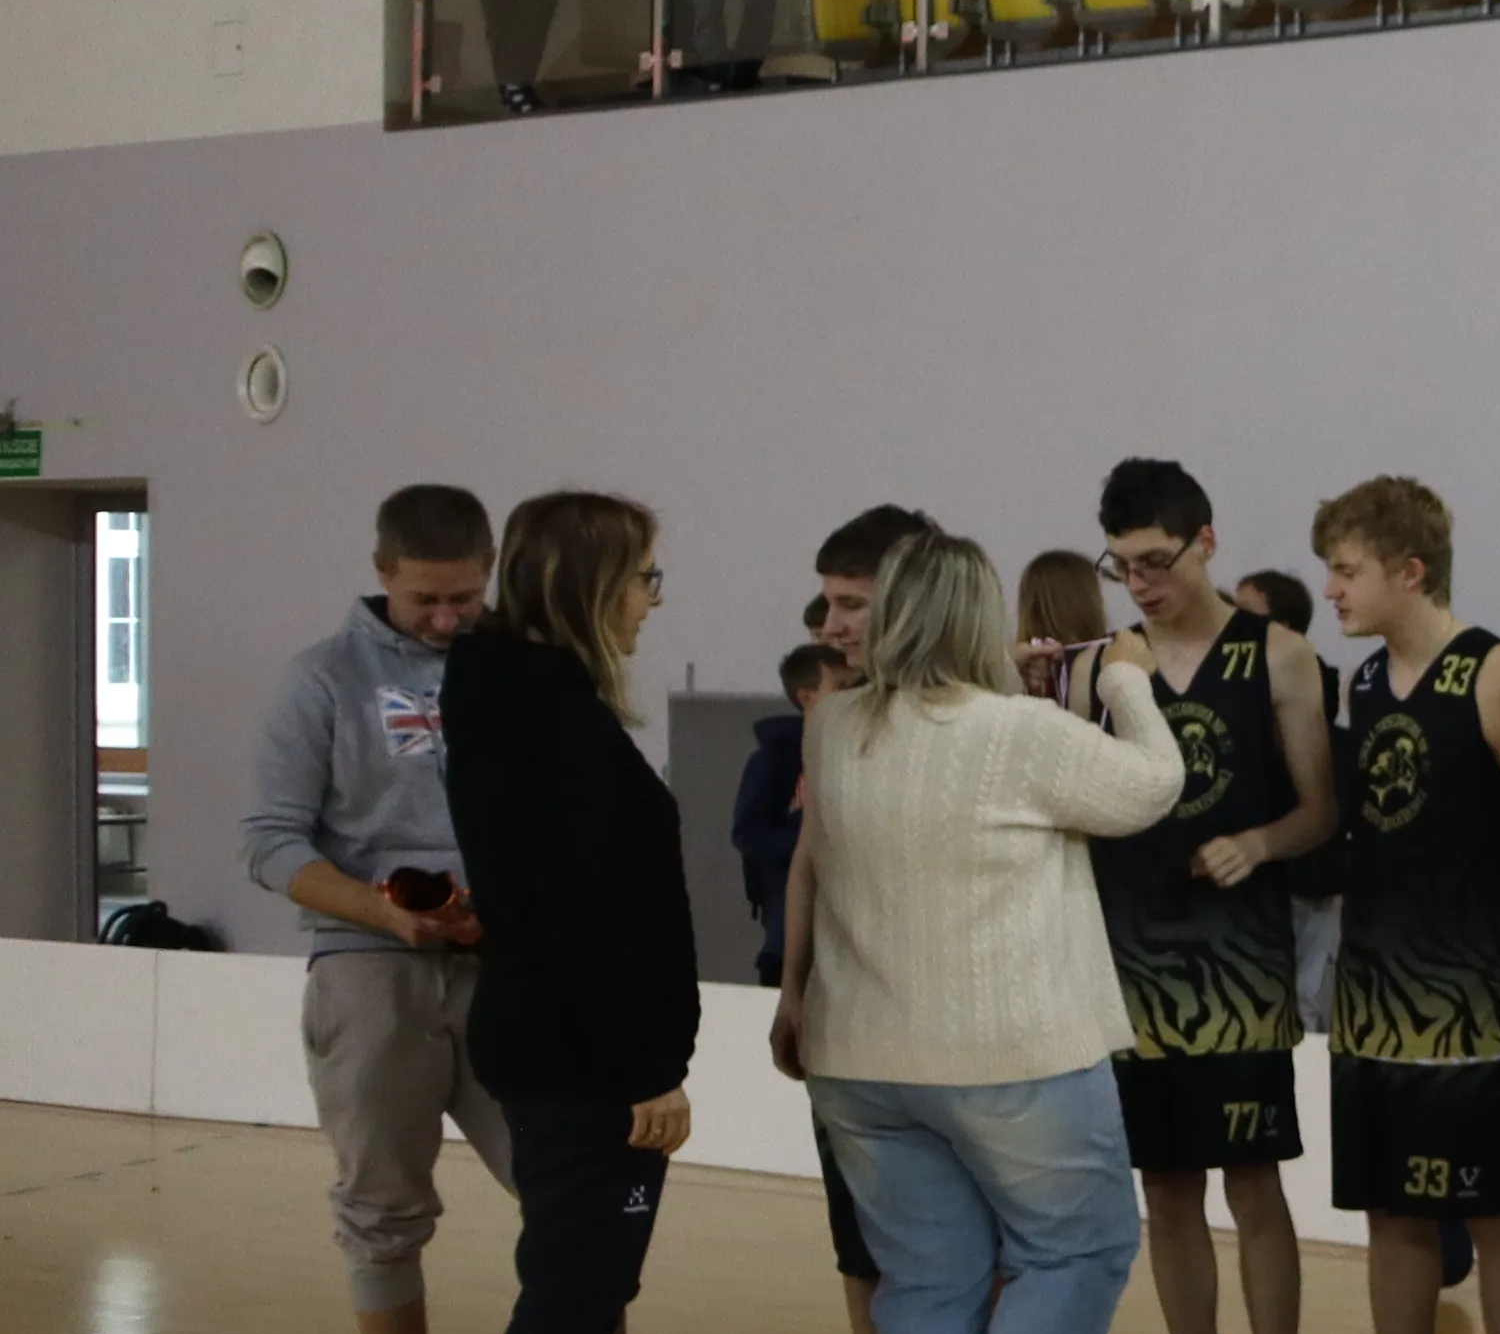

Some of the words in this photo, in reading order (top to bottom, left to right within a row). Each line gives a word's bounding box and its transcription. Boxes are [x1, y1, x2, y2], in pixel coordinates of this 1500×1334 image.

[1222, 640, 1259, 681] 77
[1434, 654, 1478, 696] 33
[1223, 1101, 1261, 1142] 77
[1404, 1155, 1449, 1198] 33
